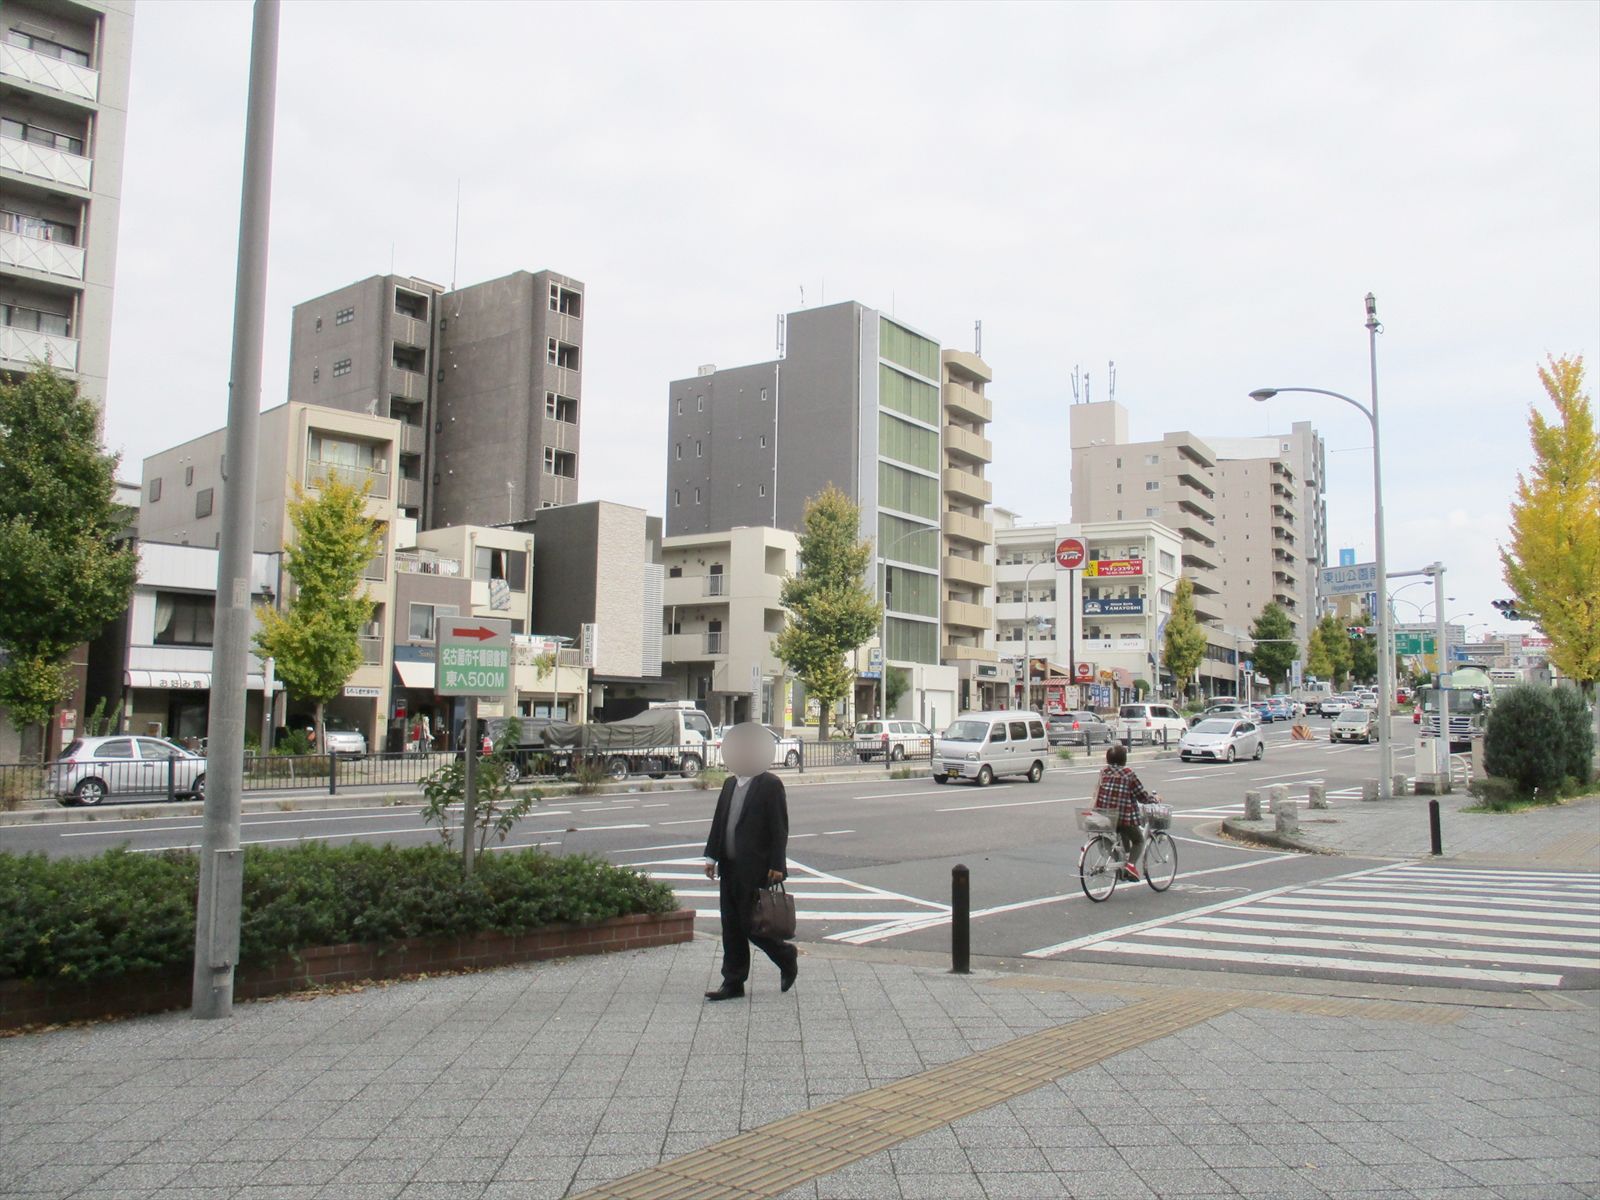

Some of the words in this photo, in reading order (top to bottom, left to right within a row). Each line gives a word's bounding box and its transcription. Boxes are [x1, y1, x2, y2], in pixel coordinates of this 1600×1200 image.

[443, 647, 508, 668] 名古屋市千種図書館
[446, 670, 505, 688] 東へ500M
